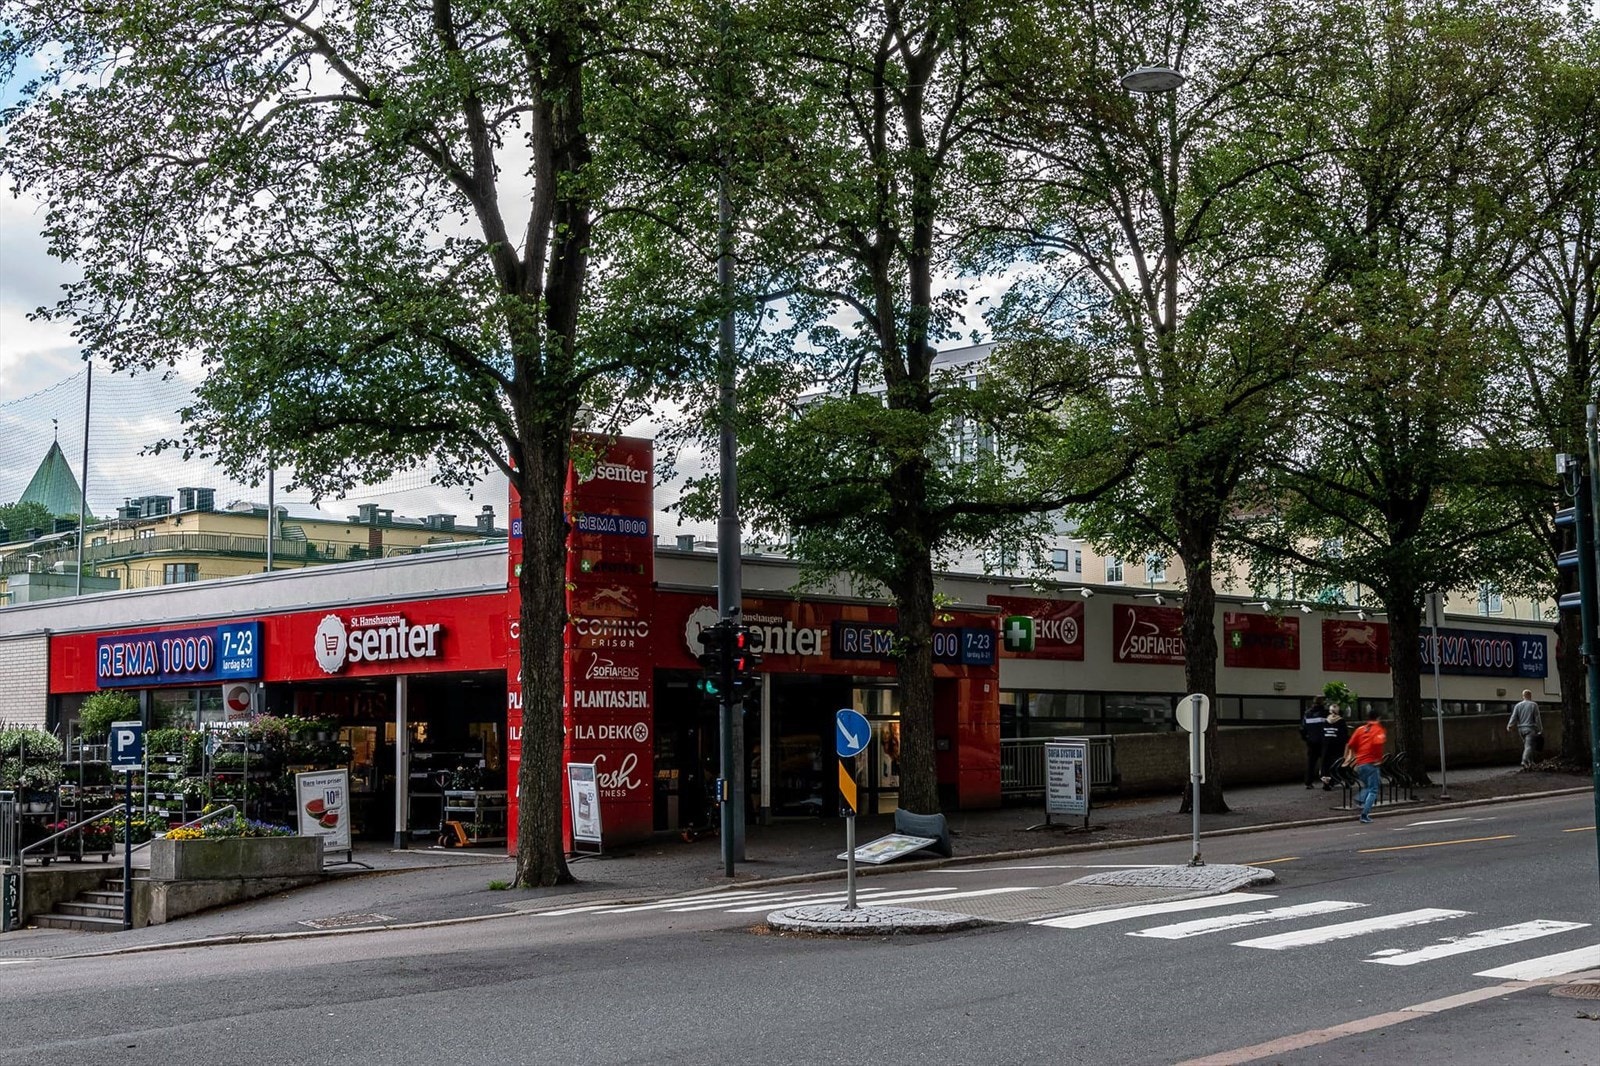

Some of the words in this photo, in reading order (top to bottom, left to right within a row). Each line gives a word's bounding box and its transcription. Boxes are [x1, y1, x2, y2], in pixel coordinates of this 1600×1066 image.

[597, 464, 649, 484] senter
[578, 514, 617, 532] REMA
[618, 518, 647, 535] 1000
[360, 614, 401, 627] Hanshaugen
[576, 618, 649, 638] COMINO
[743, 613, 783, 625] anshaugen
[750, 620, 828, 656] enter
[1036, 619, 1061, 640] EKK
[222, 630, 253, 657] 7-23
[348, 618, 440, 662] senter
[591, 638, 635, 648] FRISØR
[843, 628, 892, 653] REM
[933, 632, 958, 657] 00
[966, 633, 990, 649] 7-23
[1130, 635, 1186, 655] SOFIAREN
[1522, 640, 1543, 660] 7-23
[99, 640, 159, 677] REMA
[162, 635, 213, 673] 1000
[1473, 638, 1514, 669] 1000
[593, 666, 640, 677] SOFIARENS
[117, 730, 136, 752] P
[575, 725, 596, 740] ILA
[600, 789, 627, 797] TNESS
